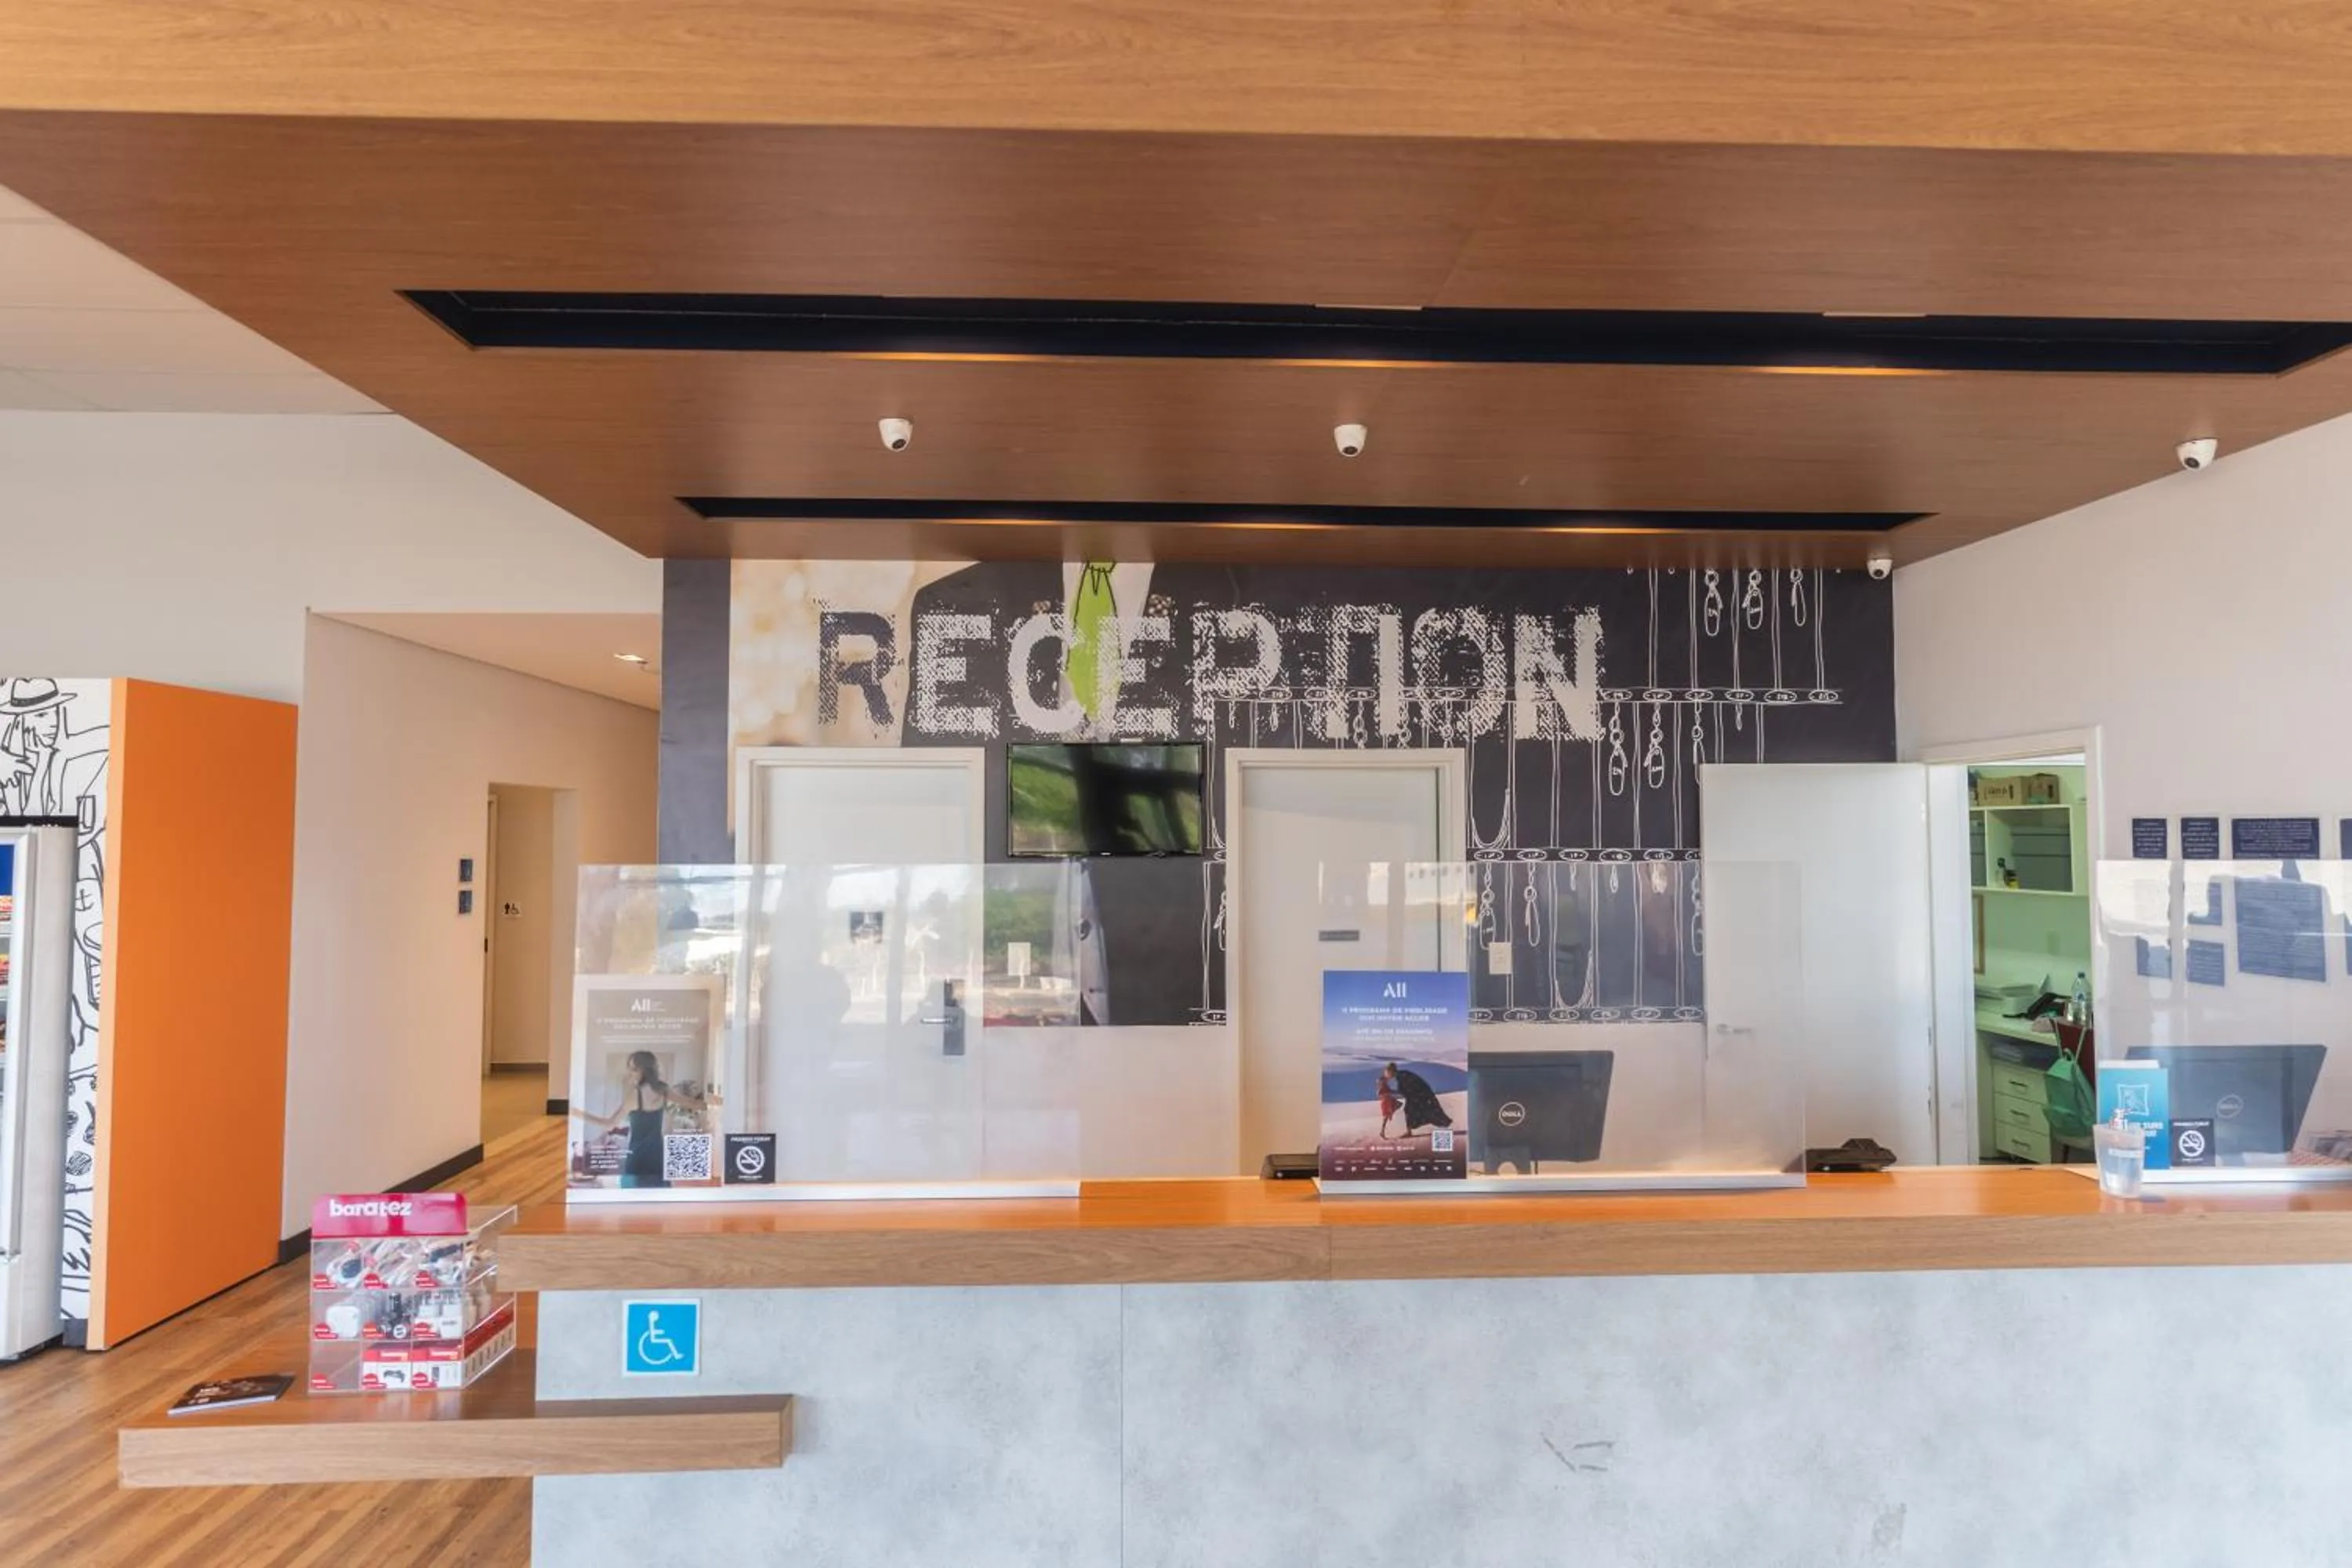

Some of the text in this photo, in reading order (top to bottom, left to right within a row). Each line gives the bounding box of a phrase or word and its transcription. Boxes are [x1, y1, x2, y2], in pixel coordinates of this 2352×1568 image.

[815, 601, 1607, 742] RECEPTION
[1383, 982, 1407, 999] All
[630, 998, 651, 1012] All
[329, 1199, 412, 1217] baratez
